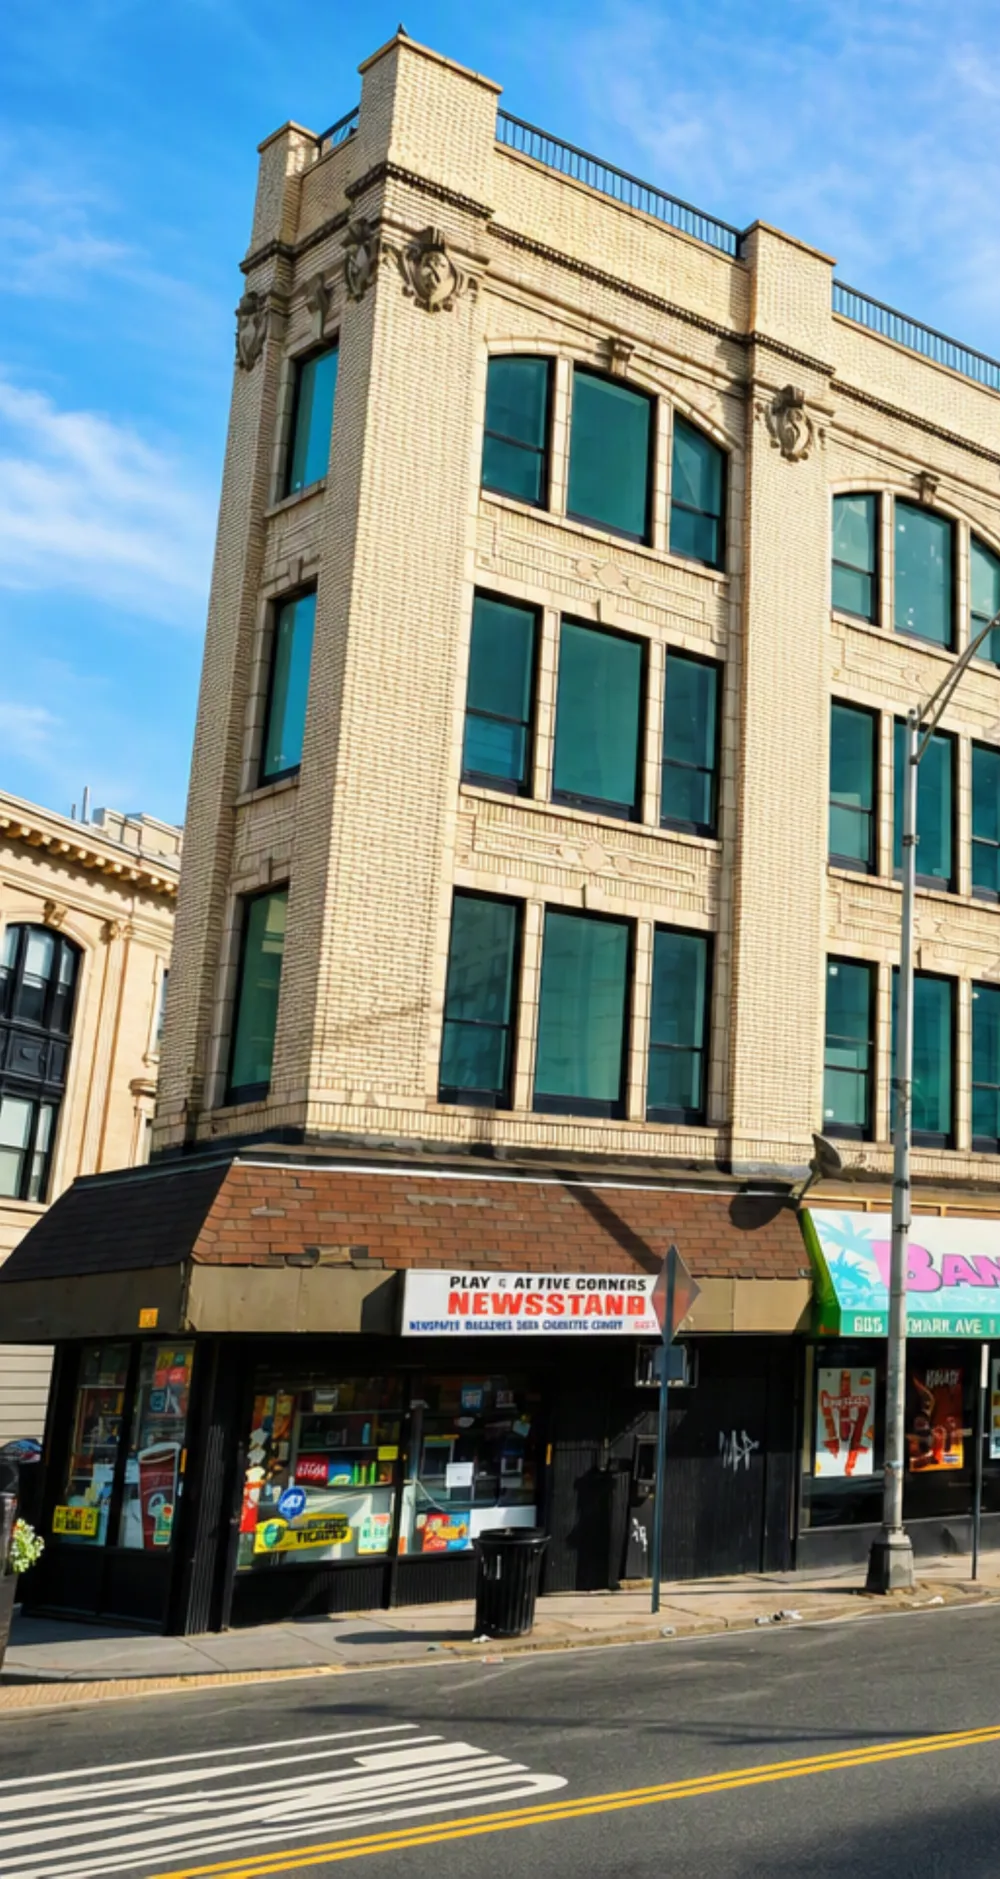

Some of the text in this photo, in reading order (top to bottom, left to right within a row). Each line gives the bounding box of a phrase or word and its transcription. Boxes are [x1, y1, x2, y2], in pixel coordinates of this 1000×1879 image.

[449, 1276, 491, 1290] PLAY
[514, 1277, 533, 1290] AT
[537, 1277, 572, 1291] FIVE
[575, 1278, 647, 1292] CORNERS
[447, 1291, 646, 1317] NEWSSTAND
[955, 1318, 983, 1334] AVE
